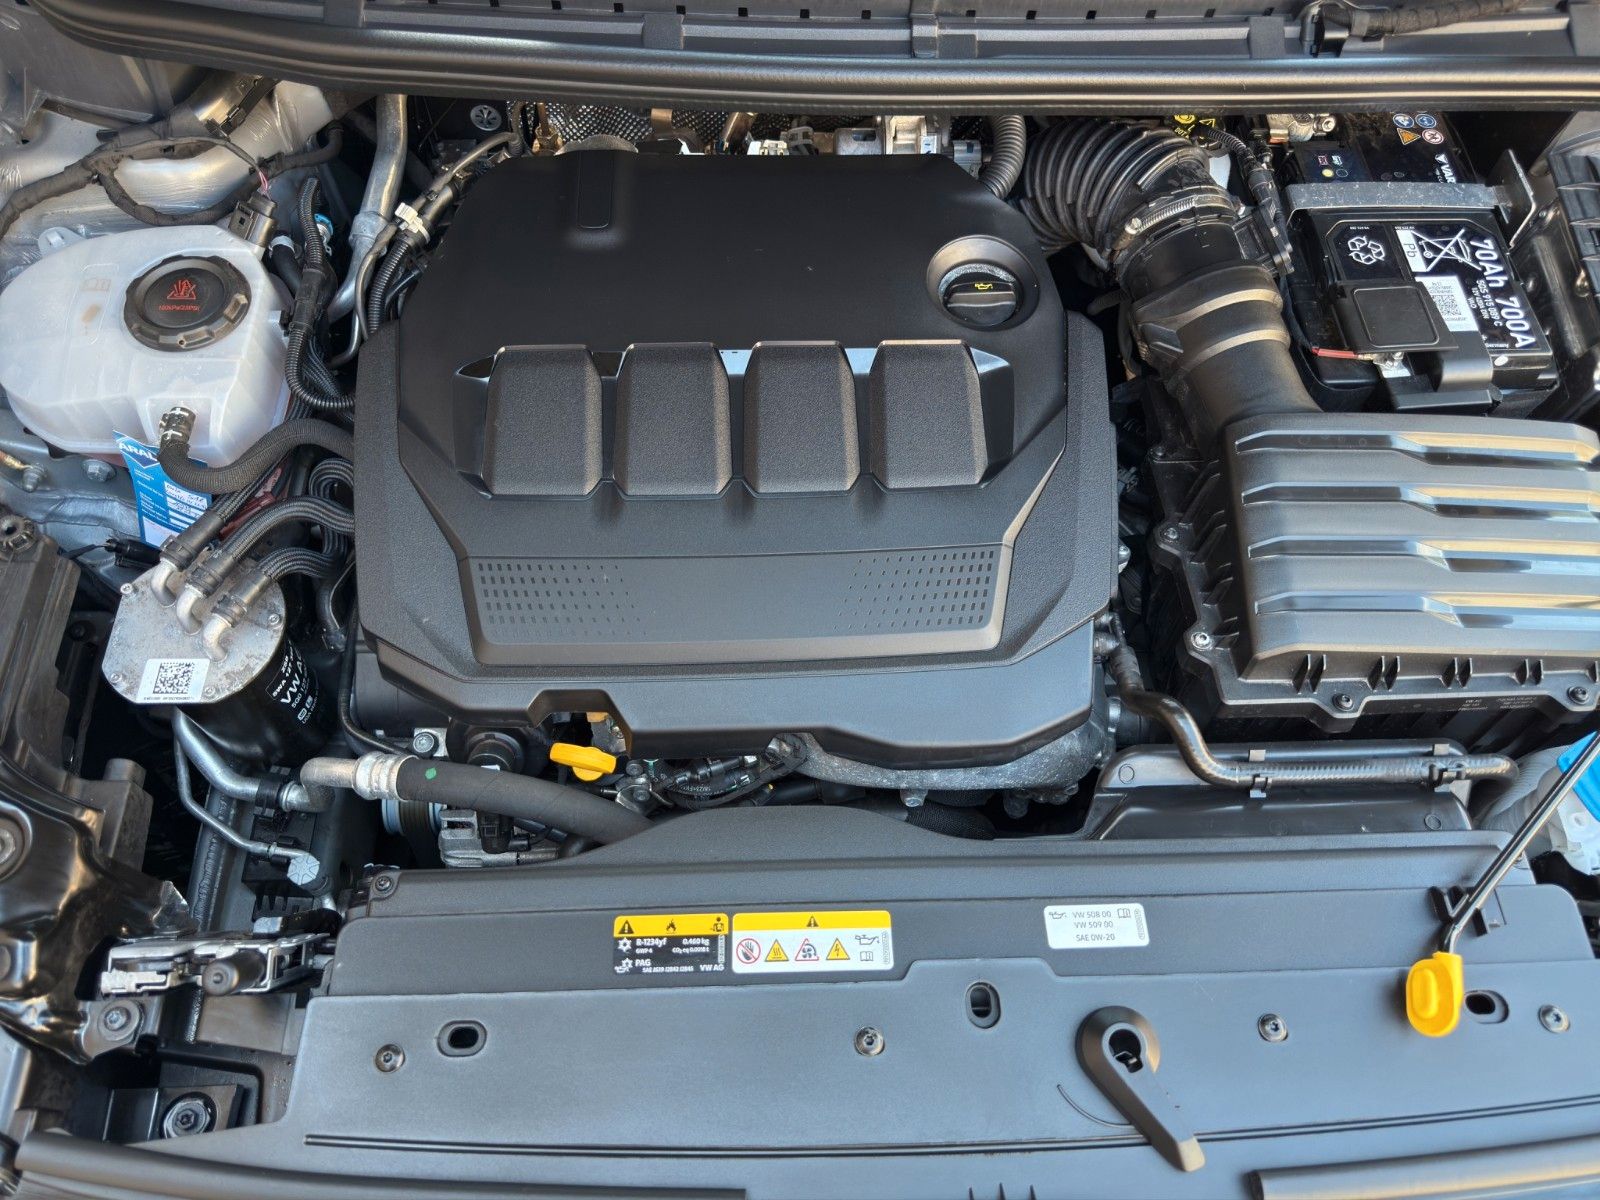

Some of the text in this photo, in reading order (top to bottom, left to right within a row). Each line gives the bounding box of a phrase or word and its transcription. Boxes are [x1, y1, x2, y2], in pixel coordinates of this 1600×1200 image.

[1441, 164, 1457, 184] VAR
[1403, 243, 1418, 258] Pb
[1470, 239, 1509, 288] 70Ah
[1495, 296, 1536, 348] 700A
[1483, 294, 1495, 308] 915
[118, 441, 158, 462] ARAL
[280, 673, 300, 704] VW
[1102, 910, 1112, 918] 00
[1104, 920, 1114, 928] 00
[636, 938, 668, 947] R-1234yf
[700, 938, 710, 946] kg
[1090, 933, 1116, 941] 0W-20
[635, 959, 652, 967] PAG
[699, 964, 713, 972] VW
